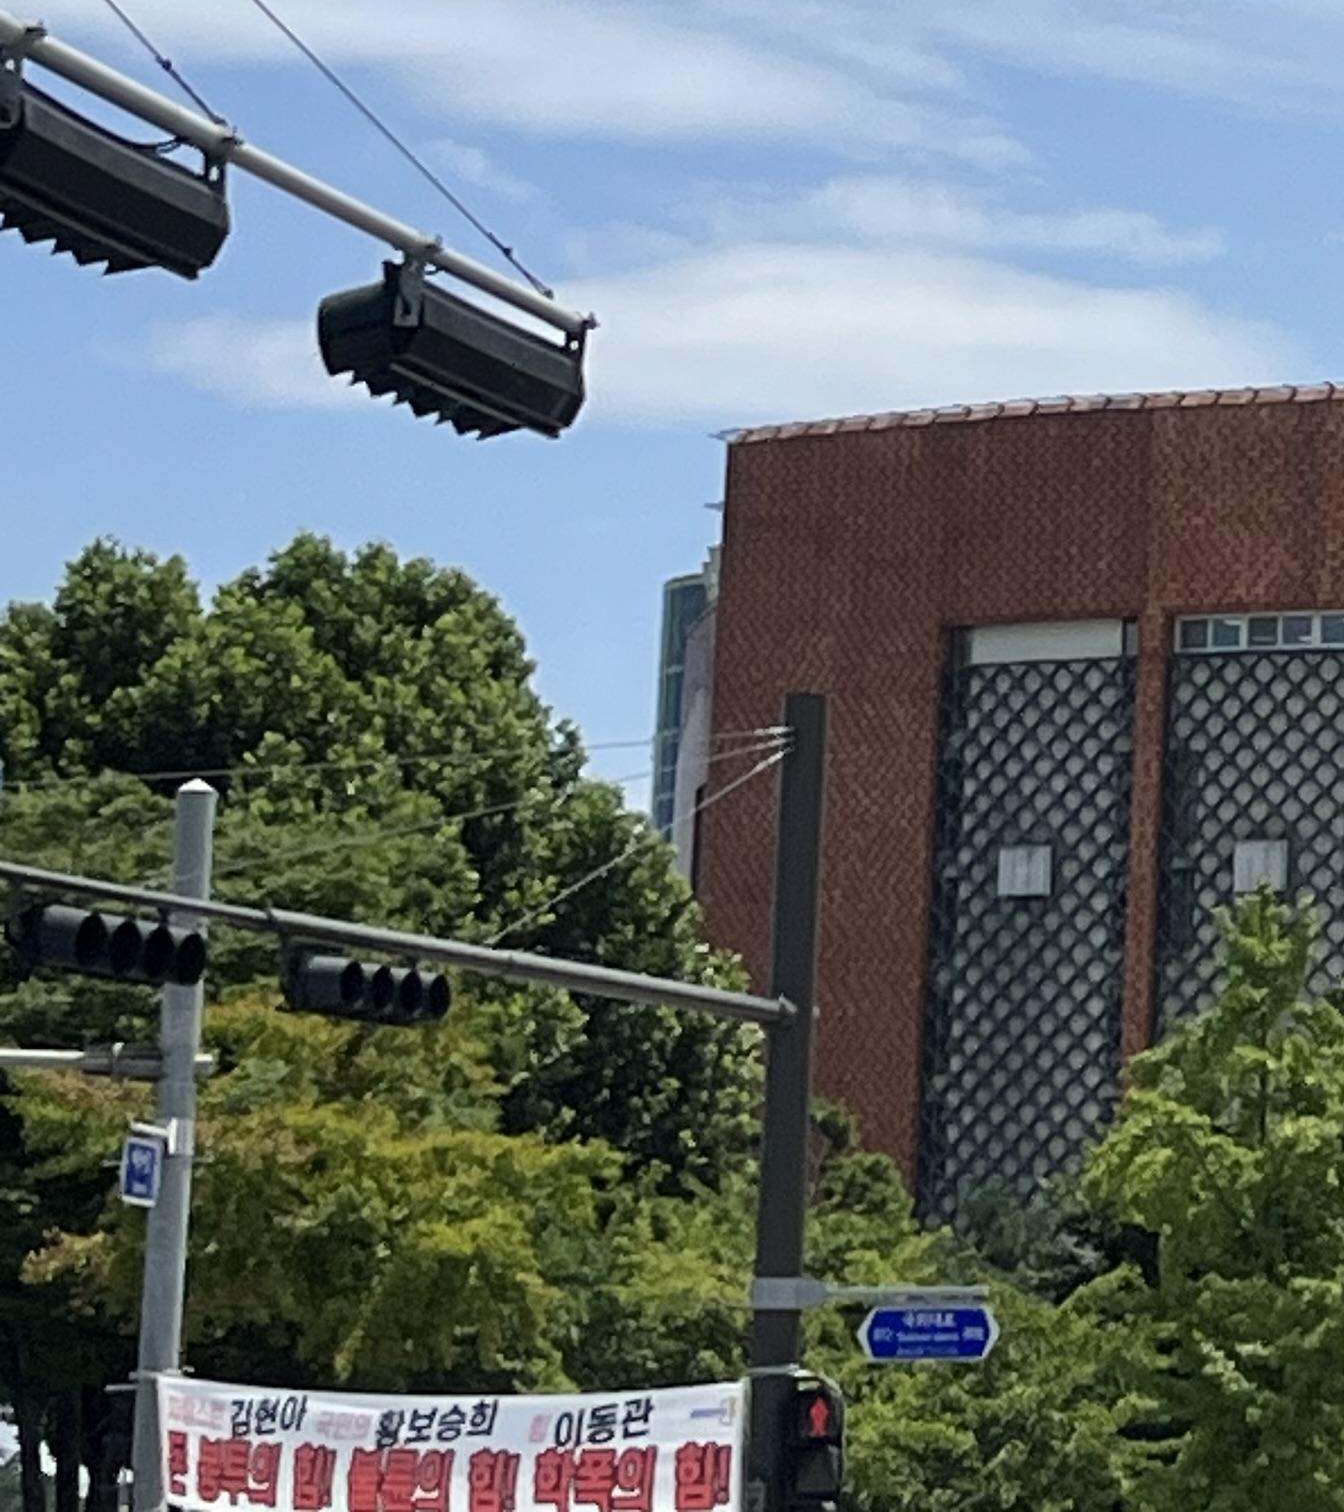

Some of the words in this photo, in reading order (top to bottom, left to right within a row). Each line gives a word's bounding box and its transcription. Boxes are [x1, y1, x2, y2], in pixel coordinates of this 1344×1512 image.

[230, 1394, 308, 1439] 김현아
[376, 1398, 499, 1449] 황보승희
[555, 1396, 654, 1448] 이동관
[198, 1435, 283, 1507] 봉투의
[293, 1442, 338, 1511] 힘!
[468, 1446, 521, 1512] 힘!
[534, 1445, 658, 1512] 학폭의
[674, 1440, 732, 1512] 힘!
